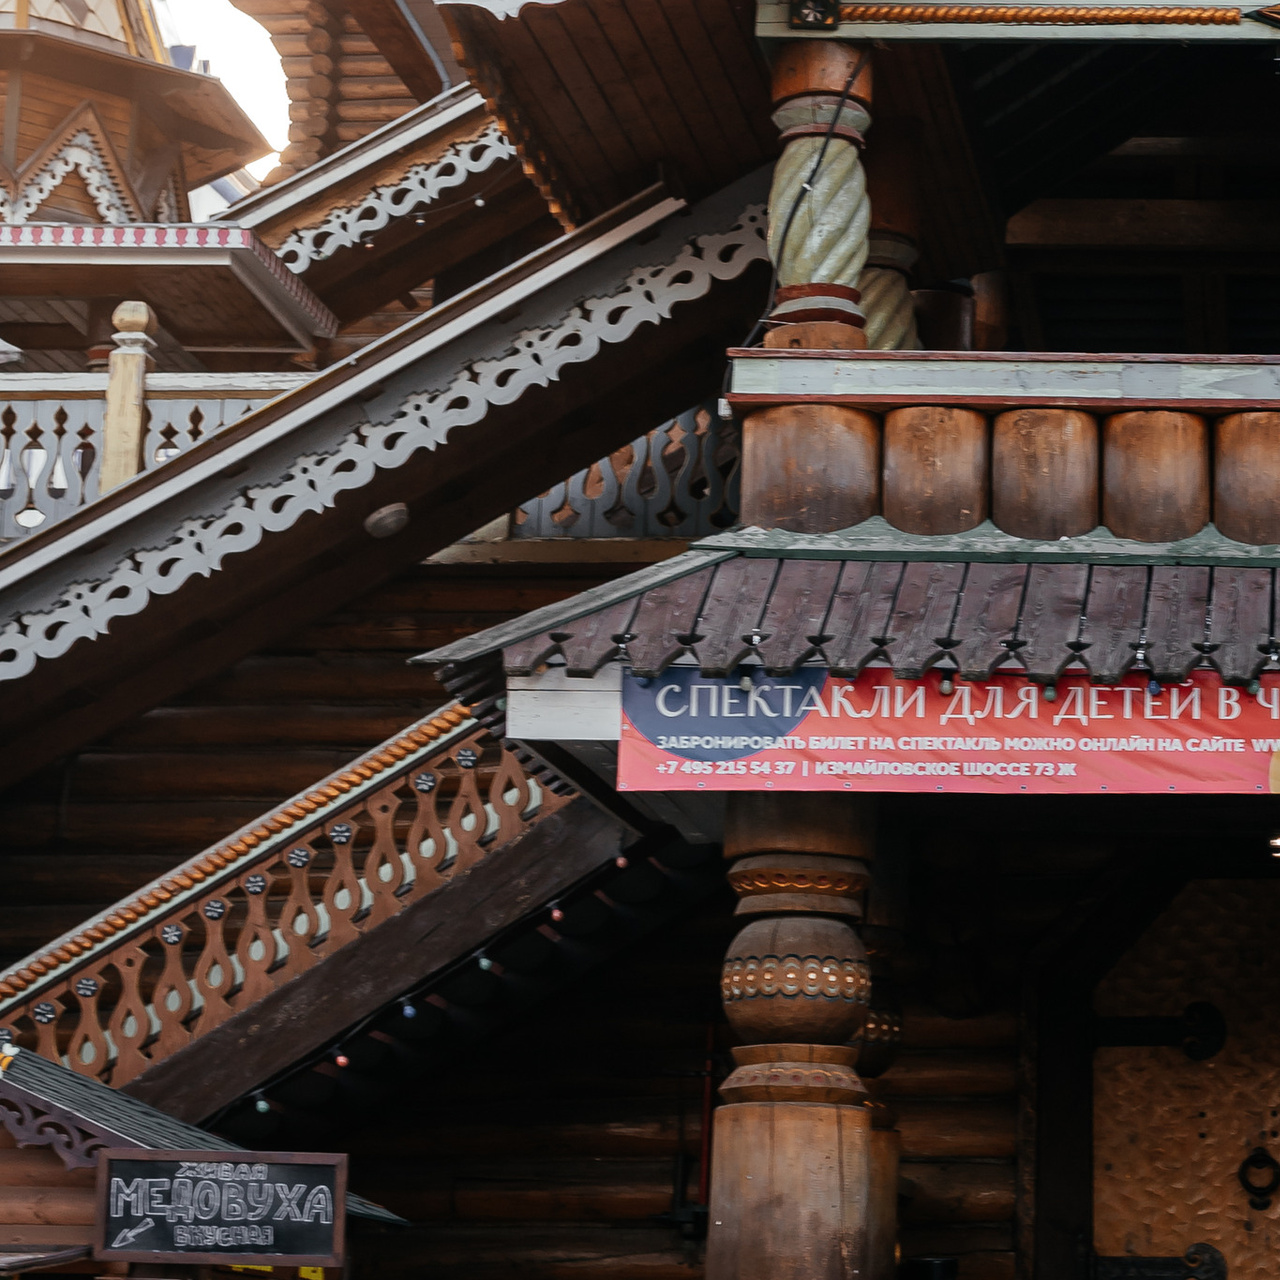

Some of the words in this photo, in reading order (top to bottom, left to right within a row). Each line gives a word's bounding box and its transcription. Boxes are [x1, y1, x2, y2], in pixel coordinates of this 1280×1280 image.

[655, 684, 925, 718] СПЕКТАКЛИ
[940, 686, 1038, 726] ДЛЯ
[1052, 679, 1201, 726] ДЕТЕЙ
[1218, 687, 1242, 720] В
[656, 735, 806, 750] ЗАБРОНИРОВАТЬ
[808, 736, 867, 751] БИЛЕТ
[869, 736, 896, 751] НА
[897, 736, 1002, 752] СПЕКТАКЛЬ
[1003, 737, 1076, 752] МОЖНО
[1079, 735, 1155, 752] ОНЛАЙН
[1157, 738, 1184, 752] НА
[1185, 735, 1245, 752] САЙТЕ
[656, 761, 678, 775] +7
[680, 761, 711, 775] 495
[714, 761, 746, 775] 215
[749, 762, 770, 775] 54
[775, 762, 794, 775] 37
[815, 760, 961, 776] ИЗМАЙЛОВСКОЕ
[963, 763, 1030, 776] ШОССЕ
[1033, 763, 1053, 776] 73
[1055, 763, 1077, 776] Ж
[175, 1162, 268, 1181] ЖИВАЯ
[110, 1177, 334, 1224] МЕДОВУХА
[173, 1225, 274, 1247] ВКУСНАЯ
